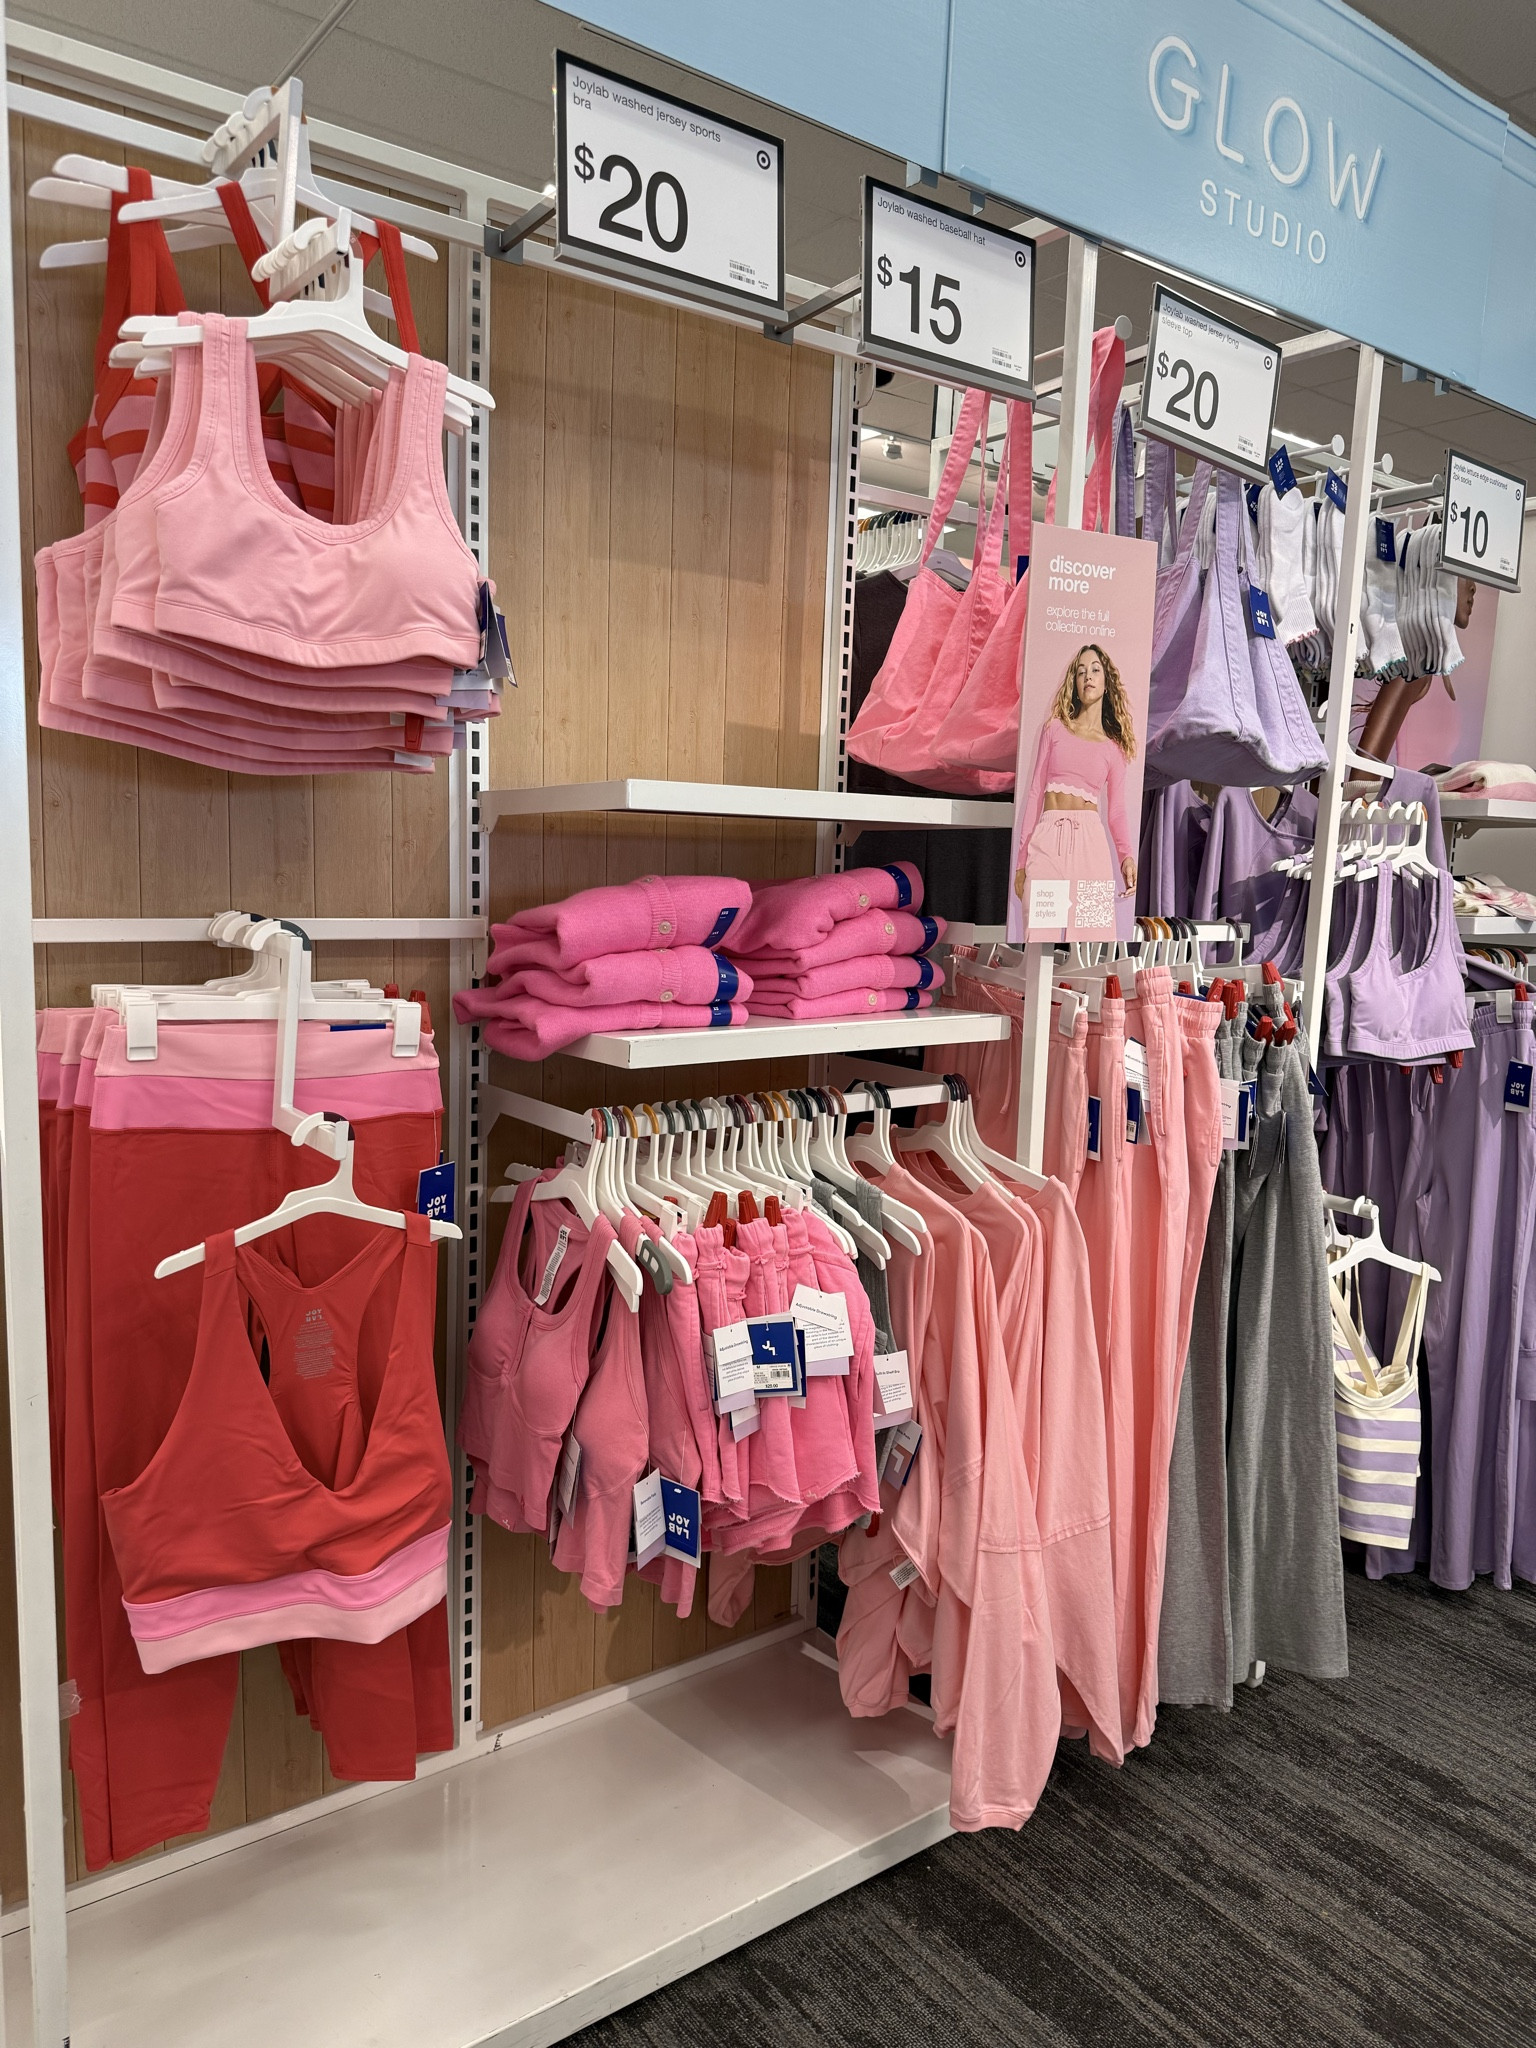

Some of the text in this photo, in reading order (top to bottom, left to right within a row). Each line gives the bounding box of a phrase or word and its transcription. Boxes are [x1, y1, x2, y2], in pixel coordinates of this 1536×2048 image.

[572, 75, 722, 143] Joylab washed jersey sports
[573, 94, 592, 111] bra
[1149, 35, 1384, 222] GLOW
[574, 142, 689, 254] $20
[877, 196, 986, 247] Joylab washed baseball hat
[1200, 178, 1327, 265] STUDIO
[876, 253, 962, 346] $15
[1161, 315, 1194, 339] sleeve top
[1162, 303, 1240, 350] Joylab washed jersey long
[1156, 350, 1220, 431] $20
[1450, 501, 1489, 559] $10
[1049, 555, 1116, 580] discover
[1048, 576, 1090, 594] more
[1046, 605, 1110, 622] explore the full
[1045, 620, 1116, 638] collection online
[1036, 890, 1054, 899] shop
[1036, 900, 1055, 908] more
[1035, 910, 1057, 919] styles
[1510, 1082, 1525, 1091] JOY
[1510, 1088, 1524, 1098] LAB
[426, 1194, 447, 1208] JOY
[426, 1204, 446, 1218] LAB
[668, 1512, 690, 1528] JOY
[668, 1522, 690, 1540] LAB
